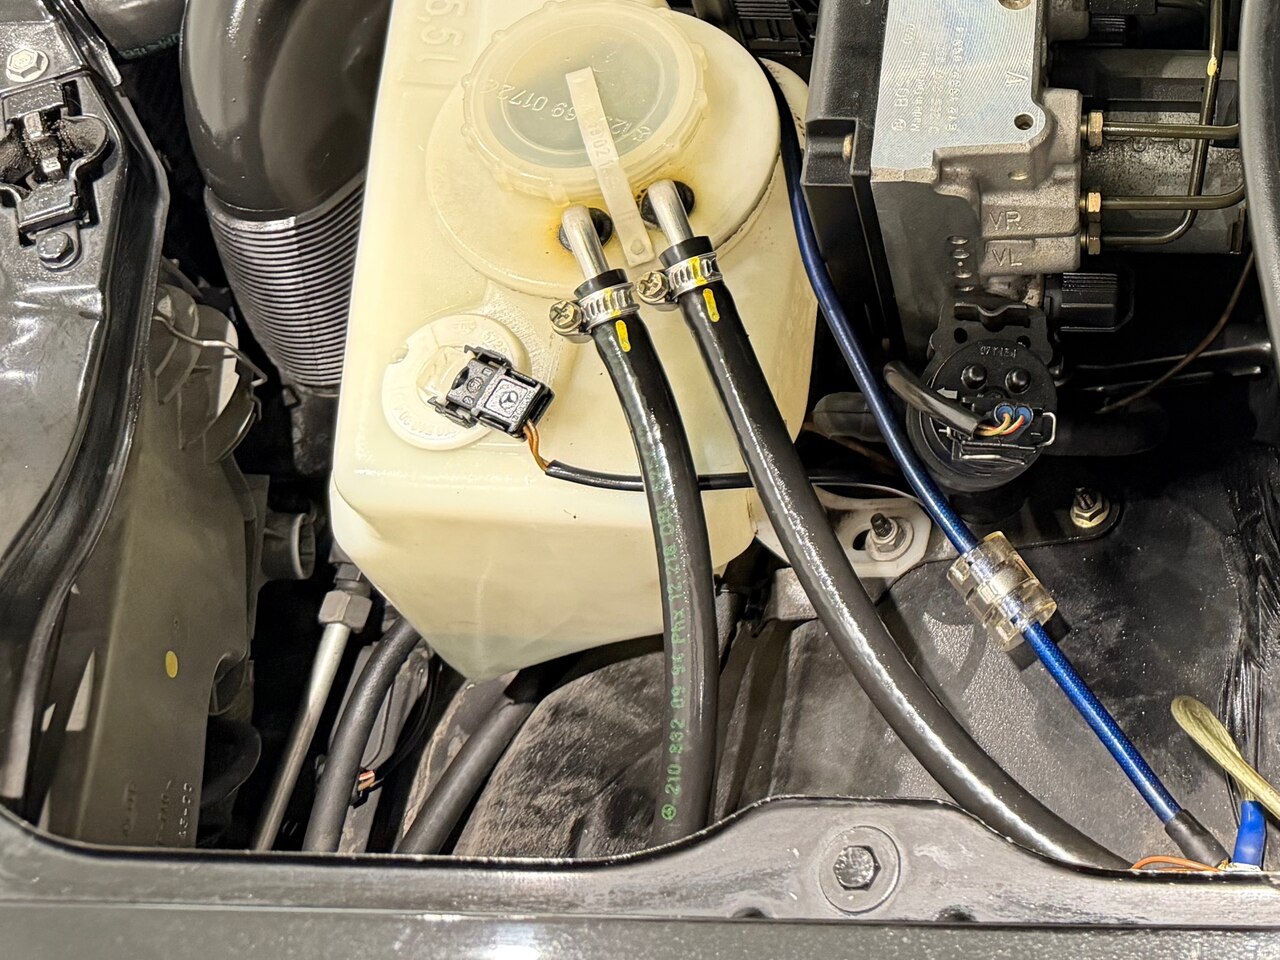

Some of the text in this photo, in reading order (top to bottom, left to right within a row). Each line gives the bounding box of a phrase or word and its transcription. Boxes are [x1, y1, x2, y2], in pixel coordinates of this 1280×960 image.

[989, 210, 1022, 231] VR
[992, 247, 1023, 267] VL
[664, 763, 682, 796] 210
